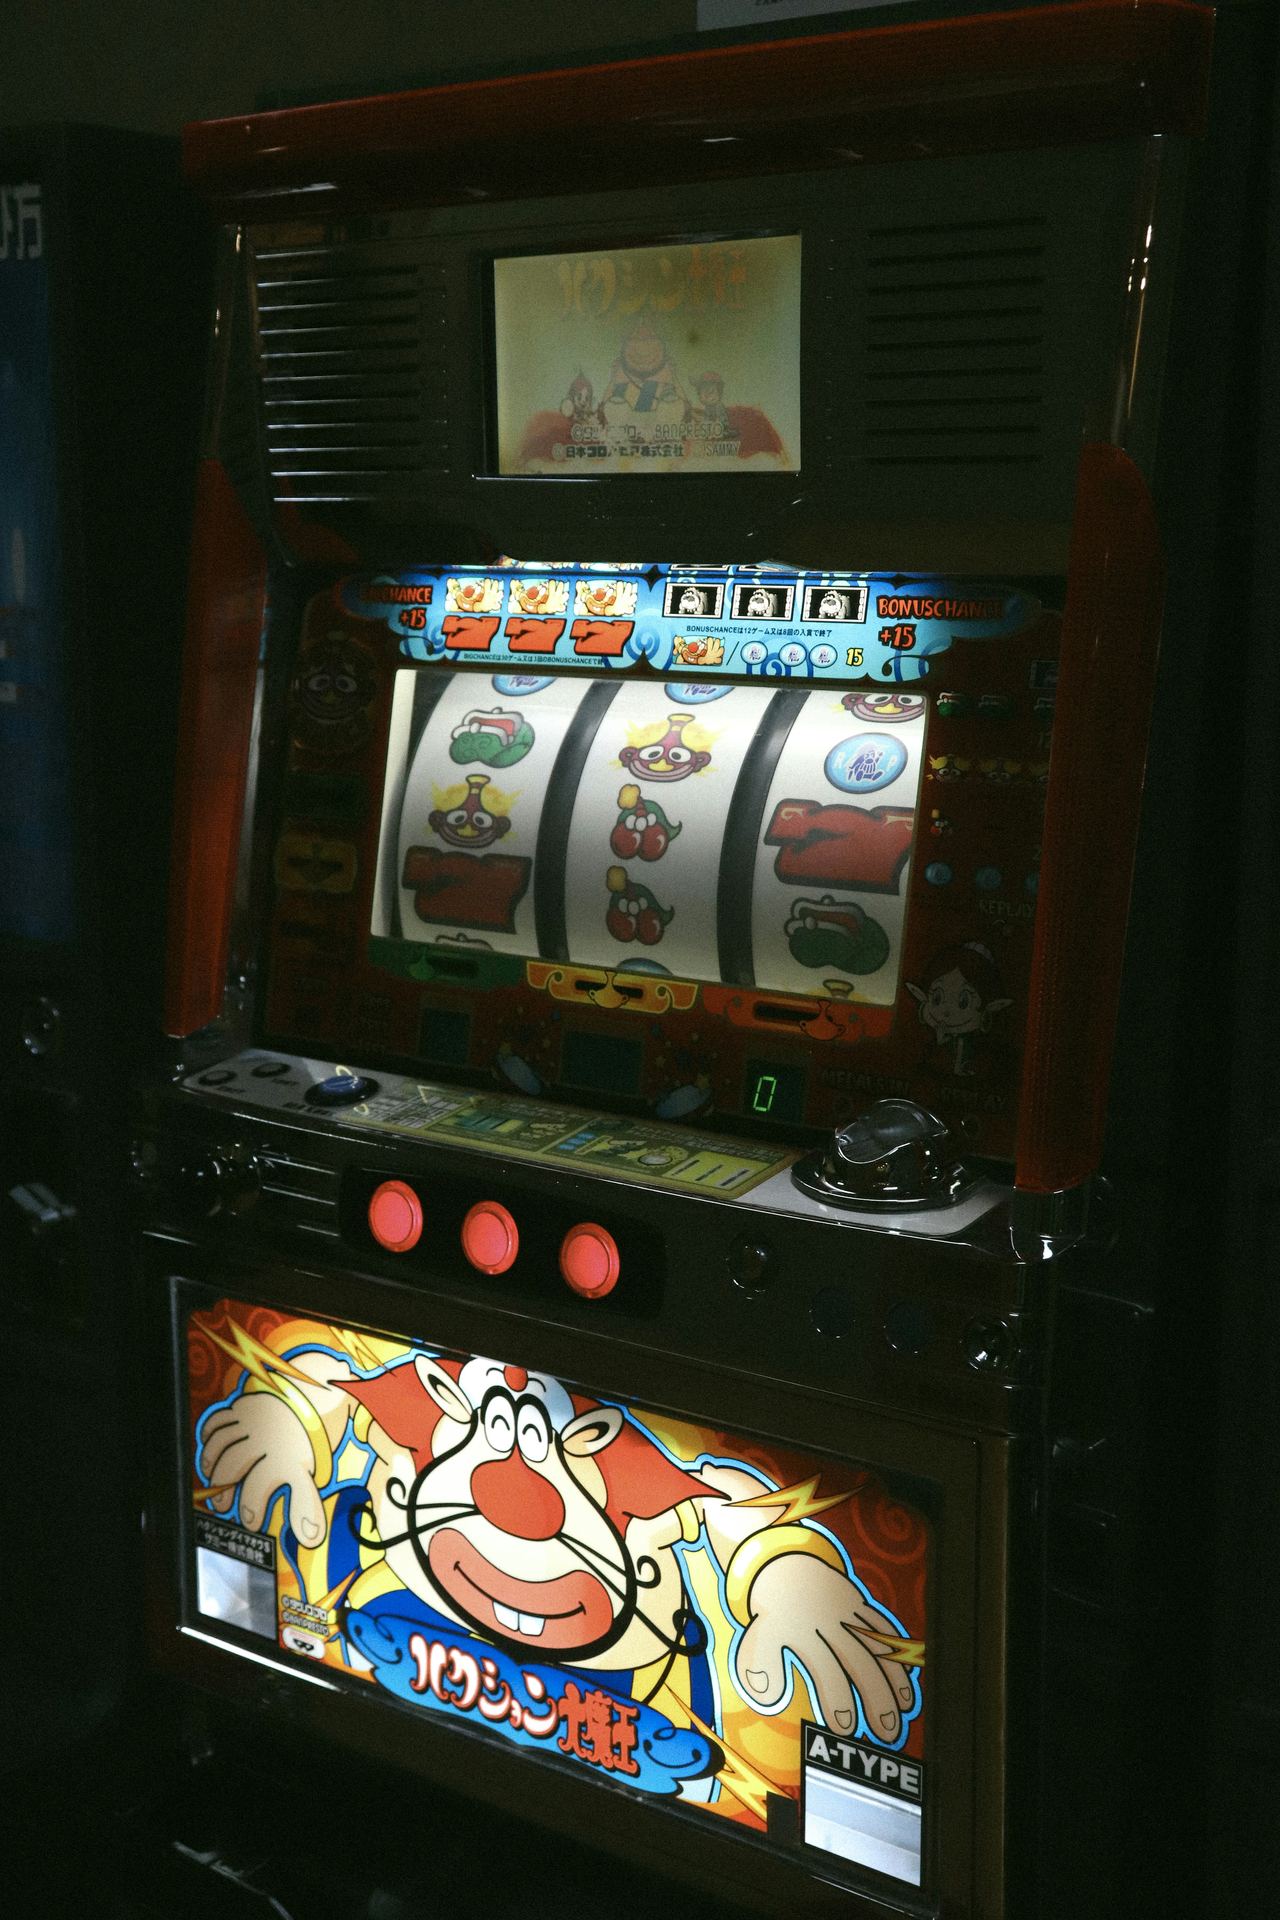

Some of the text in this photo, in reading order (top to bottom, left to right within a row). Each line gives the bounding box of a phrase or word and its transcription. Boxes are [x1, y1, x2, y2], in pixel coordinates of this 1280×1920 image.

[400, 608, 426, 629] +15
[879, 624, 916, 649] +15
[845, 647, 864, 667] 15
[753, 1076, 777, 1112] 0
[808, 1734, 920, 1795] A-TYPE
